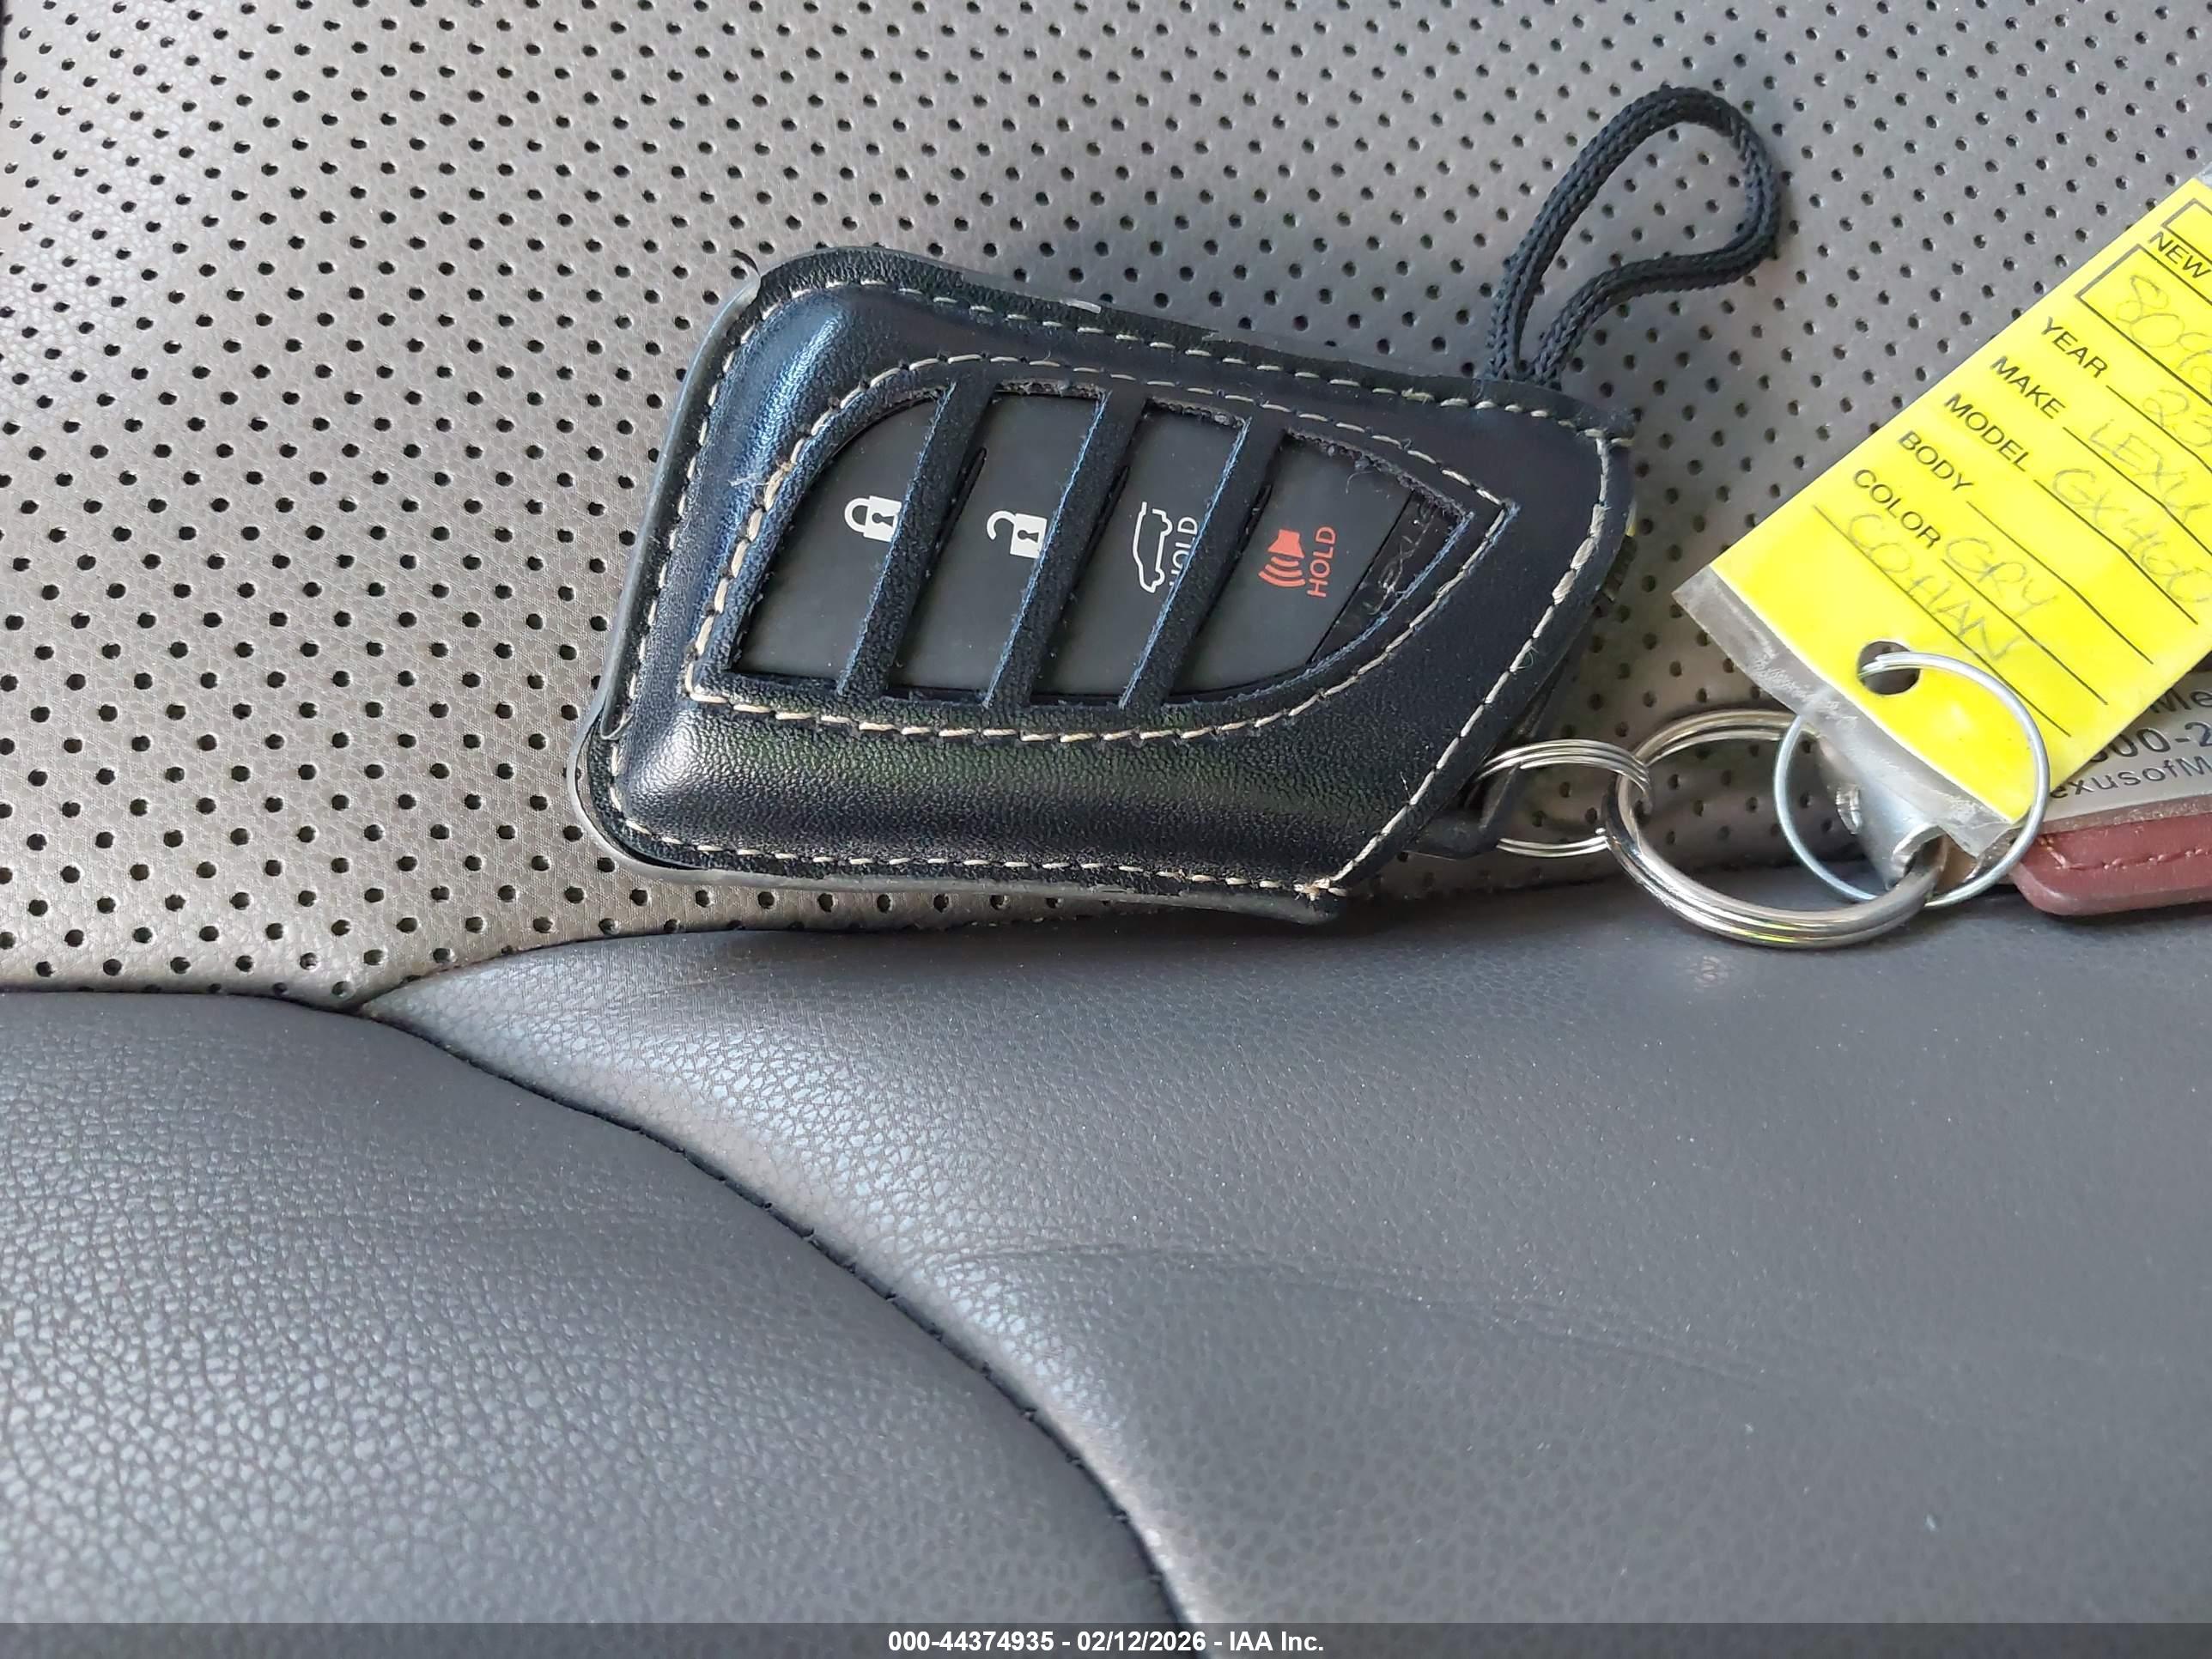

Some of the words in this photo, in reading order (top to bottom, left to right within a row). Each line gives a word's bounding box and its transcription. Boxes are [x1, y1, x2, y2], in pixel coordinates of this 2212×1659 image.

[2148, 231, 2212, 279] NEW
[2041, 316, 2109, 379] YEAR
[1990, 356, 2066, 420] MAKE
[1898, 430, 1974, 491] BODY
[1944, 393, 2031, 472] MODEL
[1853, 469, 1942, 550] COLOR
[1306, 526, 1337, 598] HOLD
